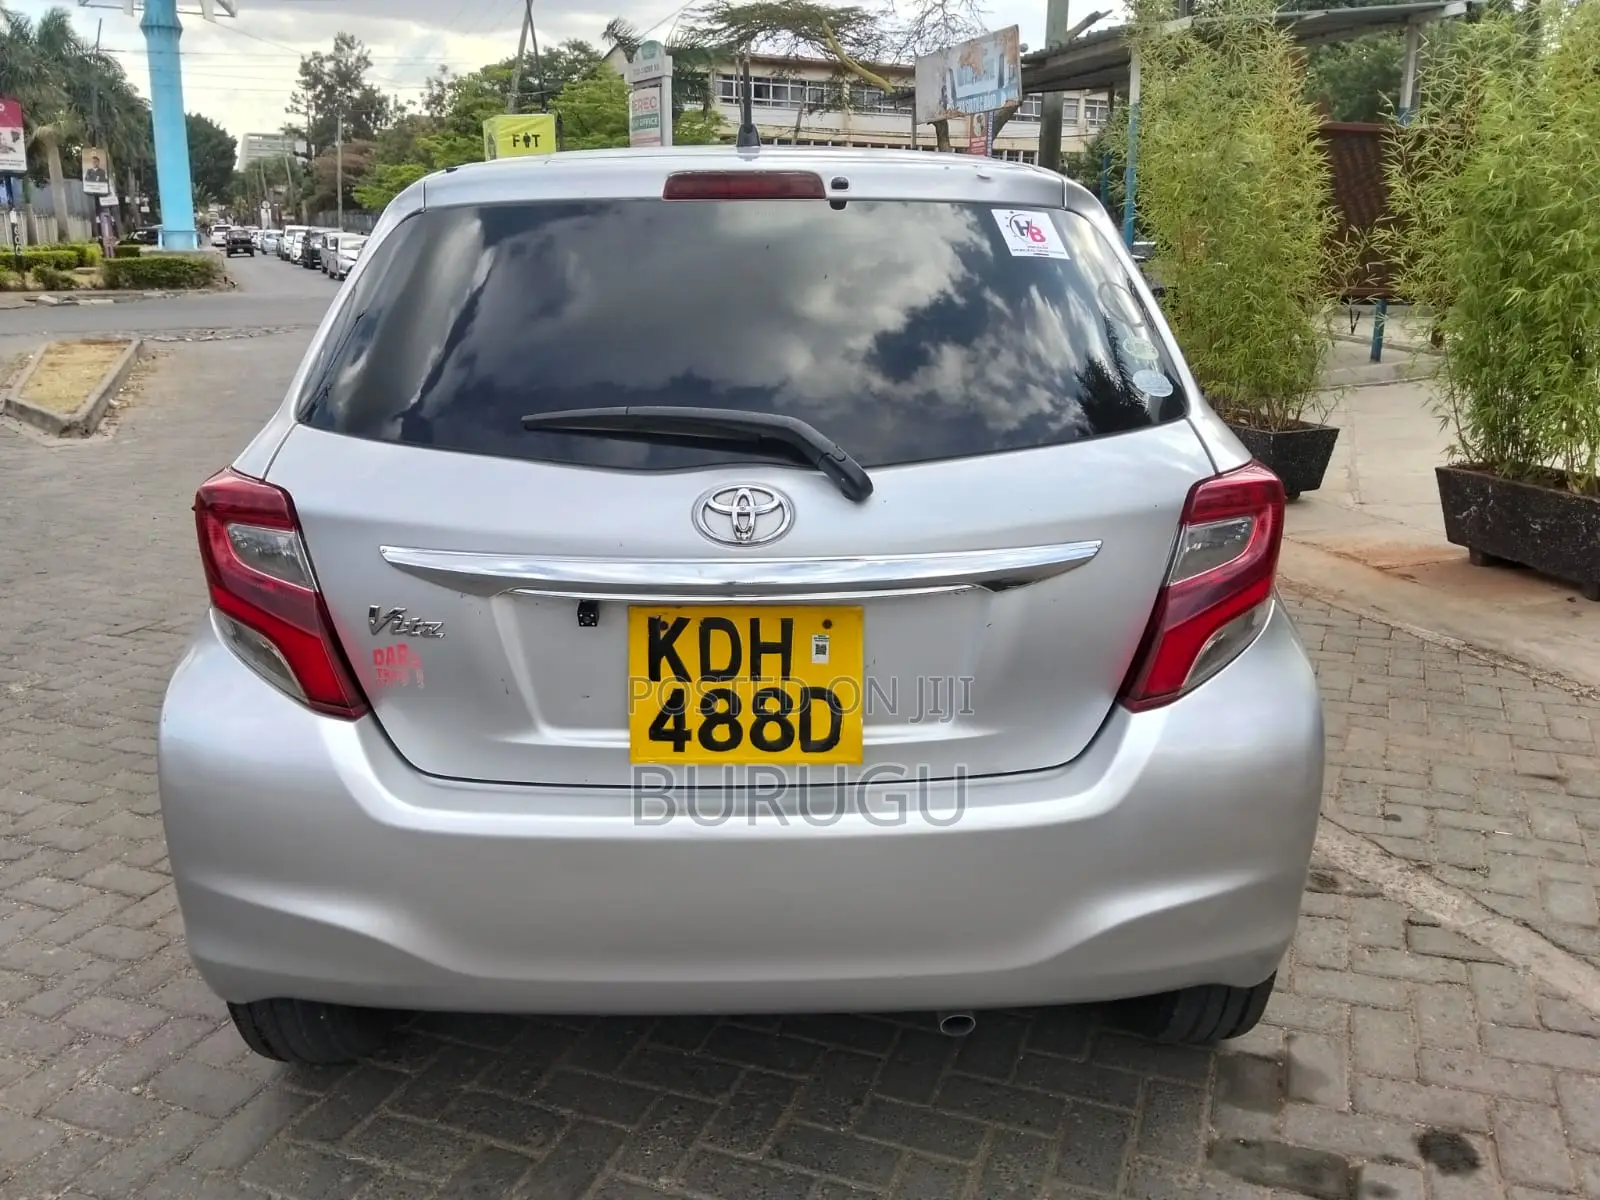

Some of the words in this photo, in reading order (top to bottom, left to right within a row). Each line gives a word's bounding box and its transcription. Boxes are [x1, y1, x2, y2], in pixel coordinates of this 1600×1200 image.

[368, 604, 446, 638] Vitz
[647, 615, 794, 683] KDH
[648, 687, 843, 754] 488D
